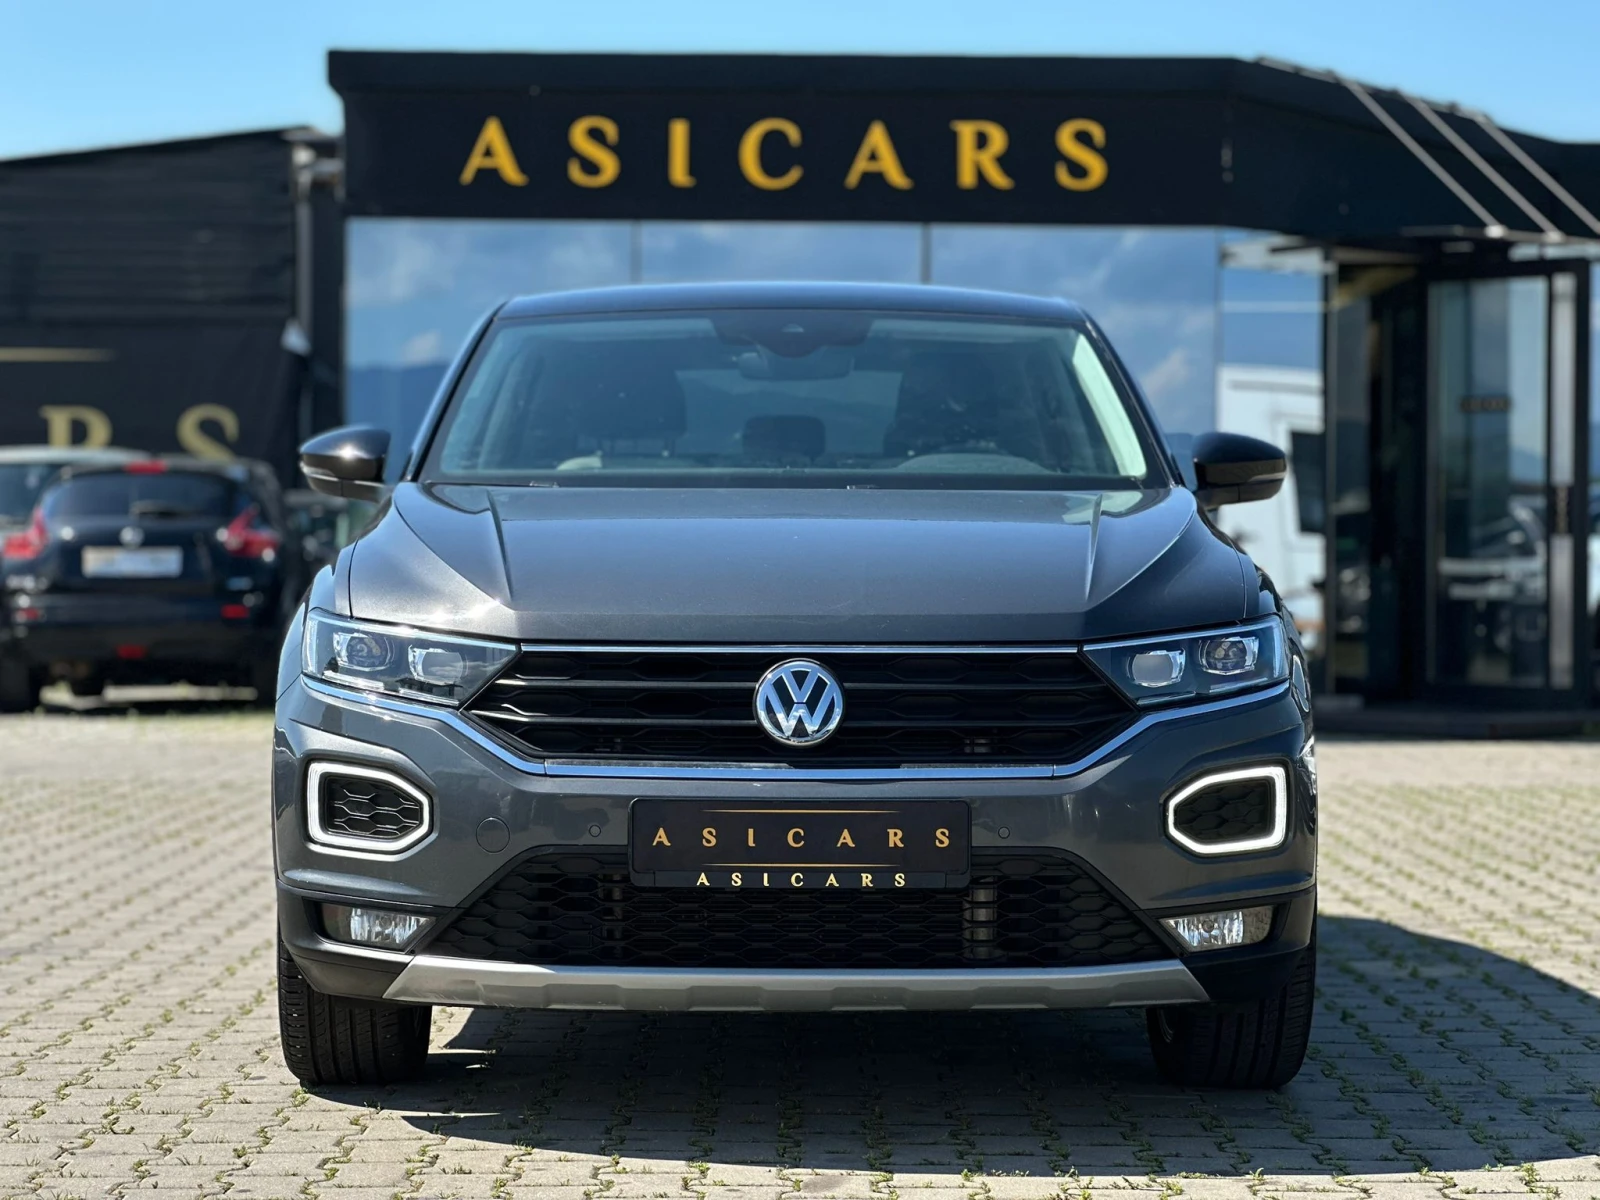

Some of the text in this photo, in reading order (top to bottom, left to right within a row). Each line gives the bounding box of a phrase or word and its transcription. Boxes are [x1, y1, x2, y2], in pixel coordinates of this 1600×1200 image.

[460, 116, 1108, 190] ASICARS
[757, 660, 843, 744] VW
[652, 827, 950, 848] ASICARS
[696, 872, 906, 887] ASICARS
